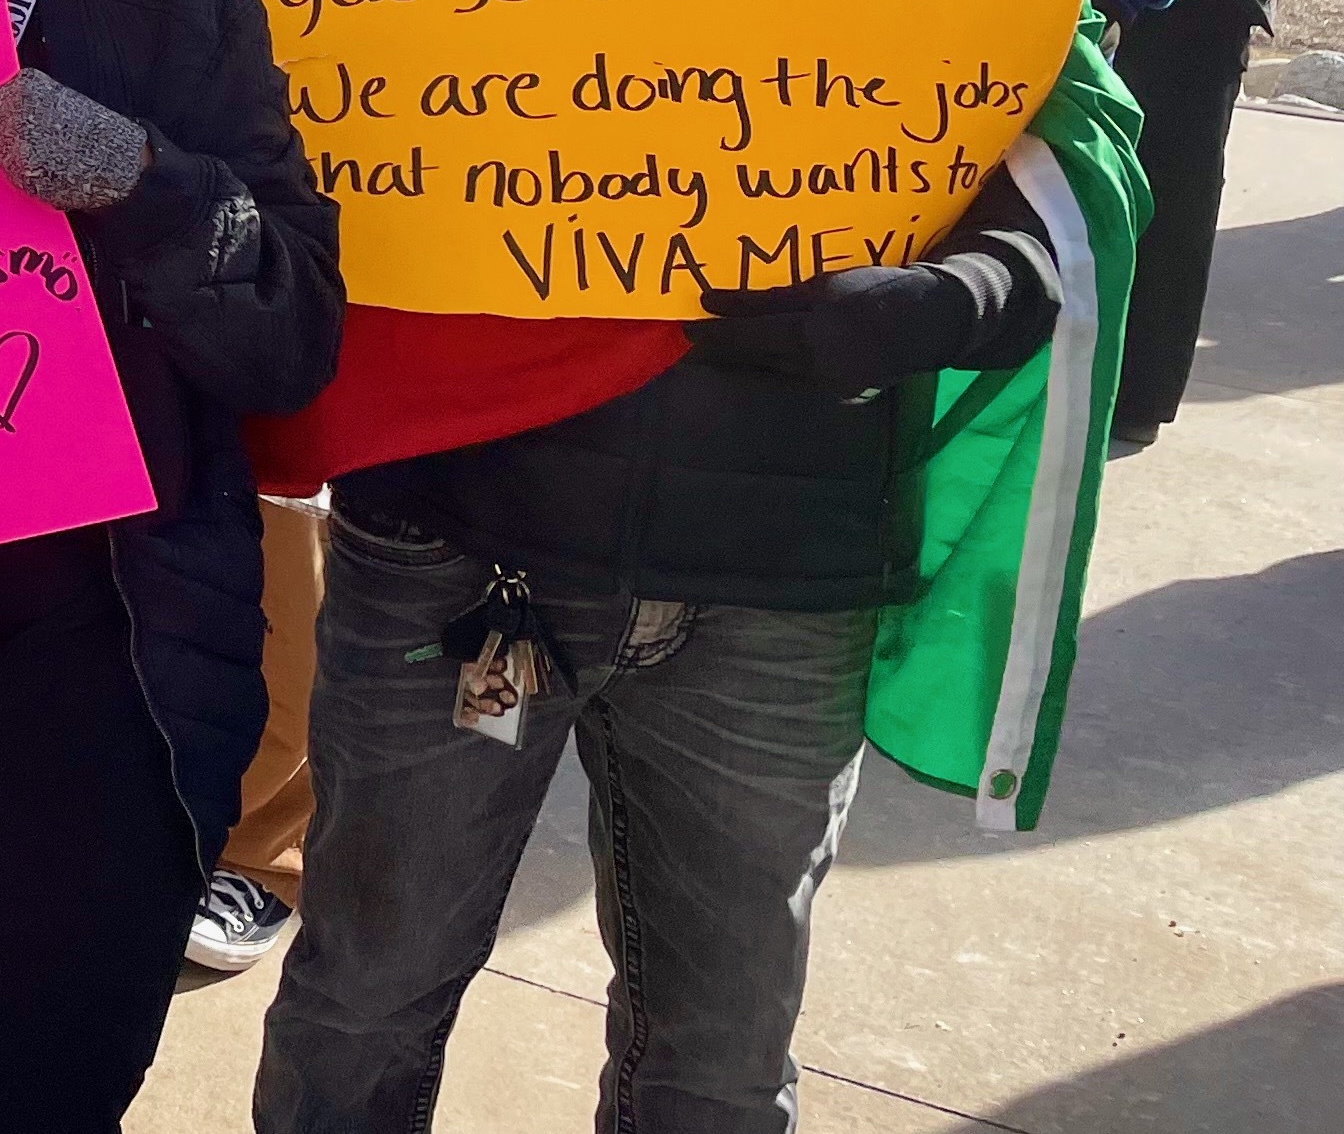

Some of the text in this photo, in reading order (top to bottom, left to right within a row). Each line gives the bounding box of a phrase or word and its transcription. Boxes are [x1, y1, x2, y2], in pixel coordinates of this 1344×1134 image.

[287, 52, 1029, 152] We are doing the jobs
[464, 149, 708, 228] nobody
[737, 146, 931, 199] wants
[948, 145, 979, 195] to
[502, 213, 709, 302] VIVA
